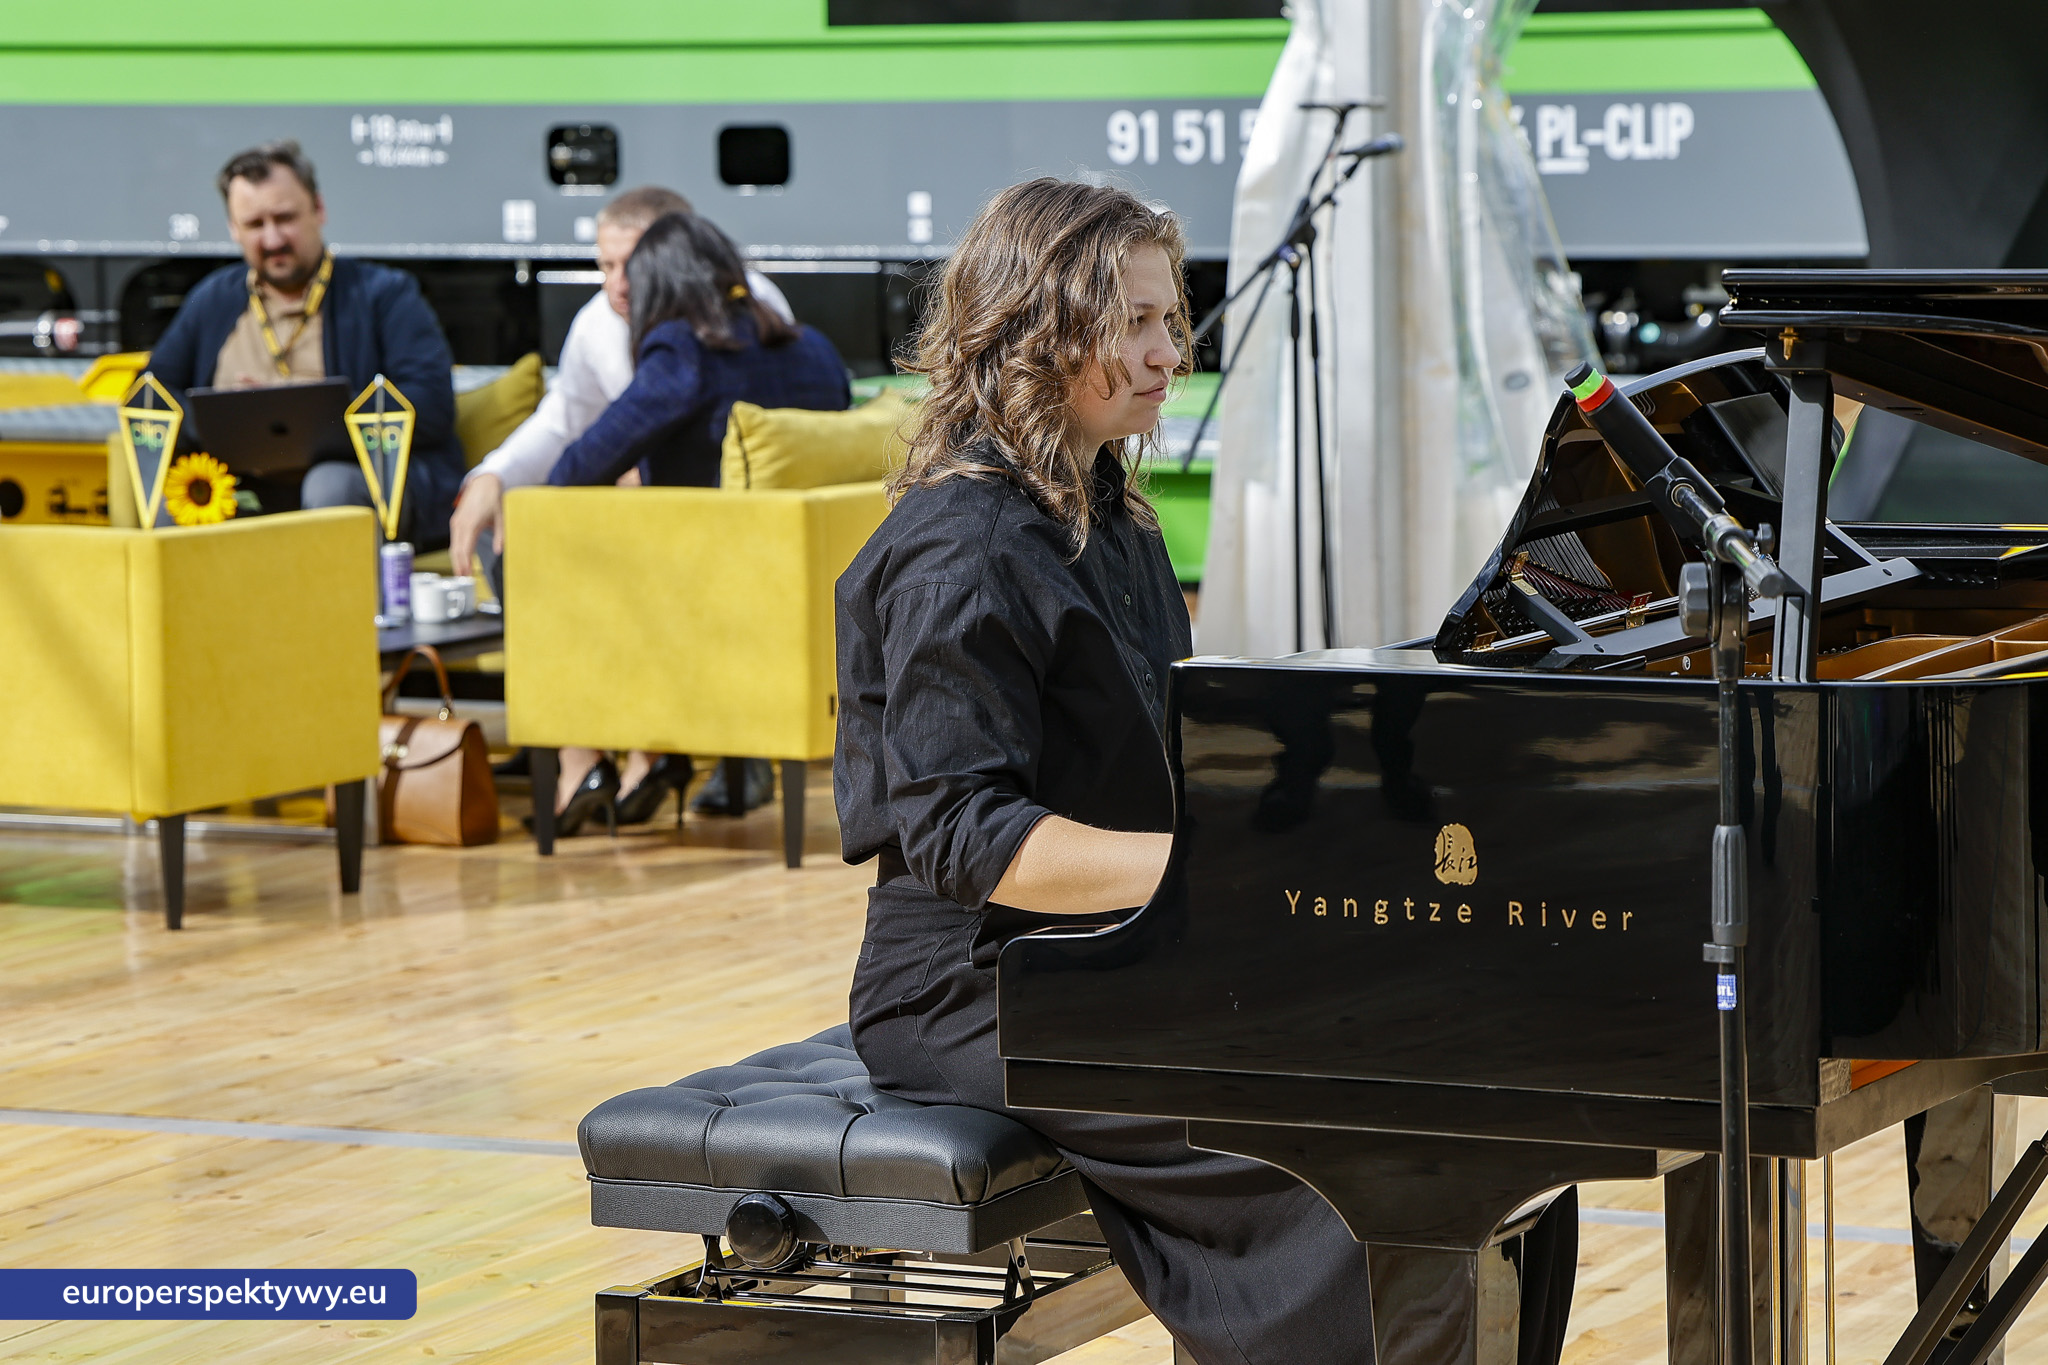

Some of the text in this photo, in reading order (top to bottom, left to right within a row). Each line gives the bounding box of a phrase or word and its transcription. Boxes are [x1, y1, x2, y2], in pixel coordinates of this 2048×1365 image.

[1107, 109, 1159, 165] 91
[1173, 109, 1226, 165] 51
[1537, 102, 1694, 161] PL-CLIP
[1285, 889, 1633, 931] Yangtze River
